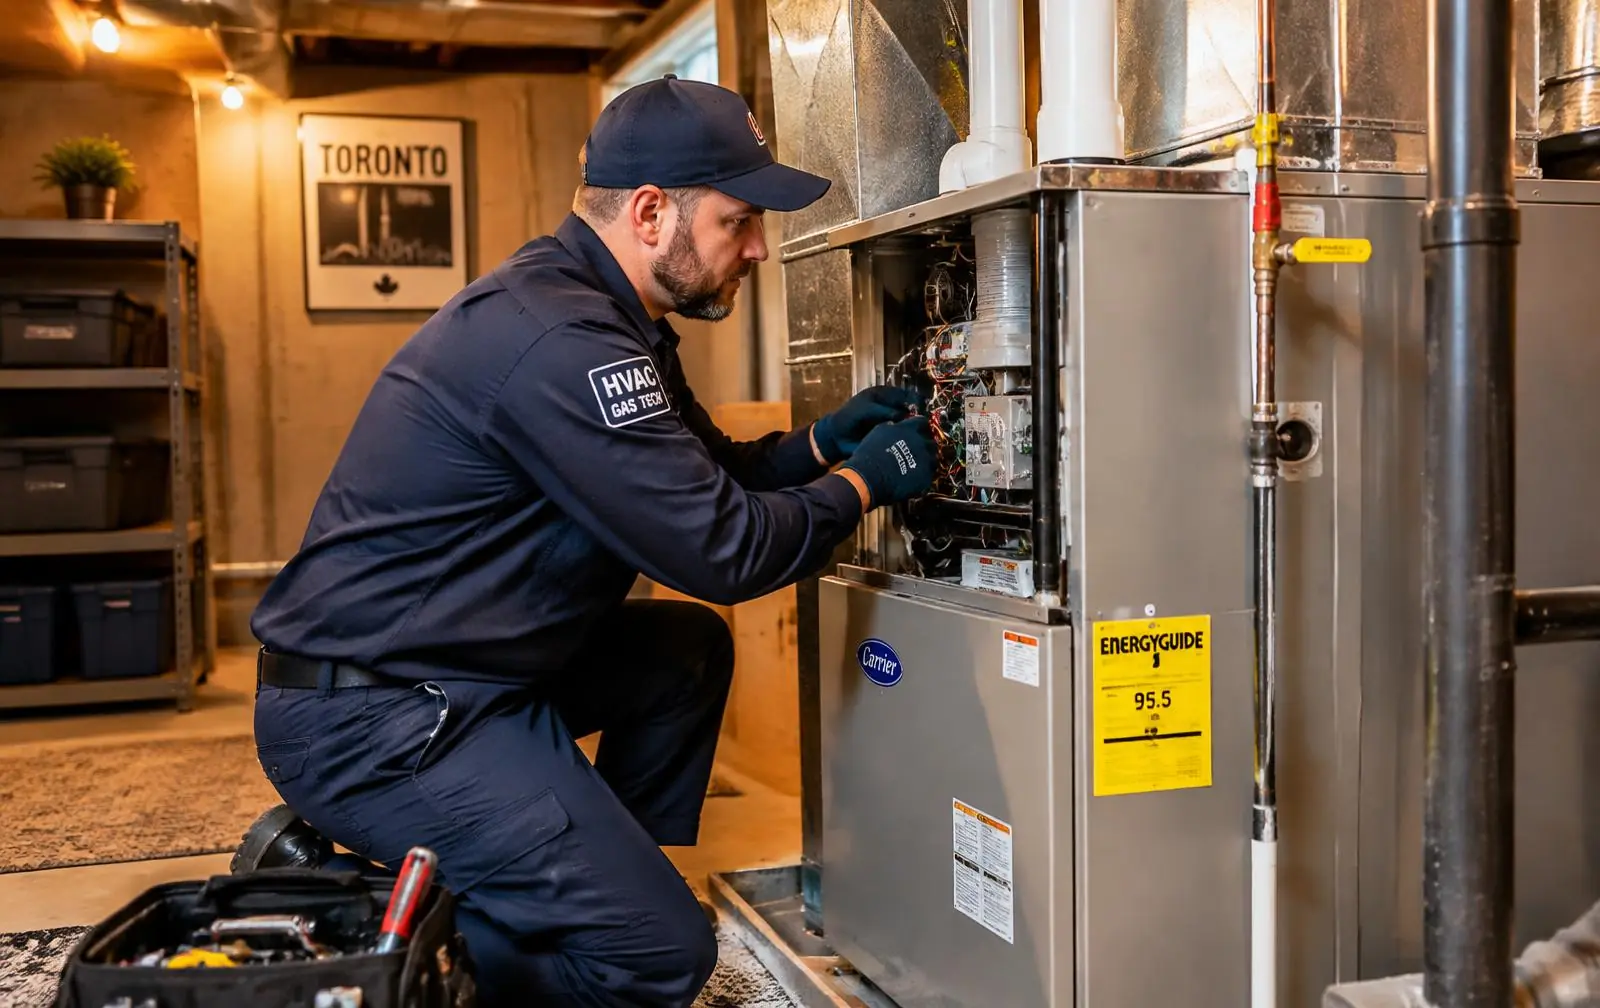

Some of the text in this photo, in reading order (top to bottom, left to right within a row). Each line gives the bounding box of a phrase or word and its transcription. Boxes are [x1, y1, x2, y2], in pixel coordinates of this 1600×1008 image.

[320, 144, 447, 177] TORONTO
[601, 365, 656, 398] HVAC
[611, 391, 664, 418] GAS TECH
[862, 646, 897, 676] Carrier
[1134, 690, 1172, 711] 95.5
